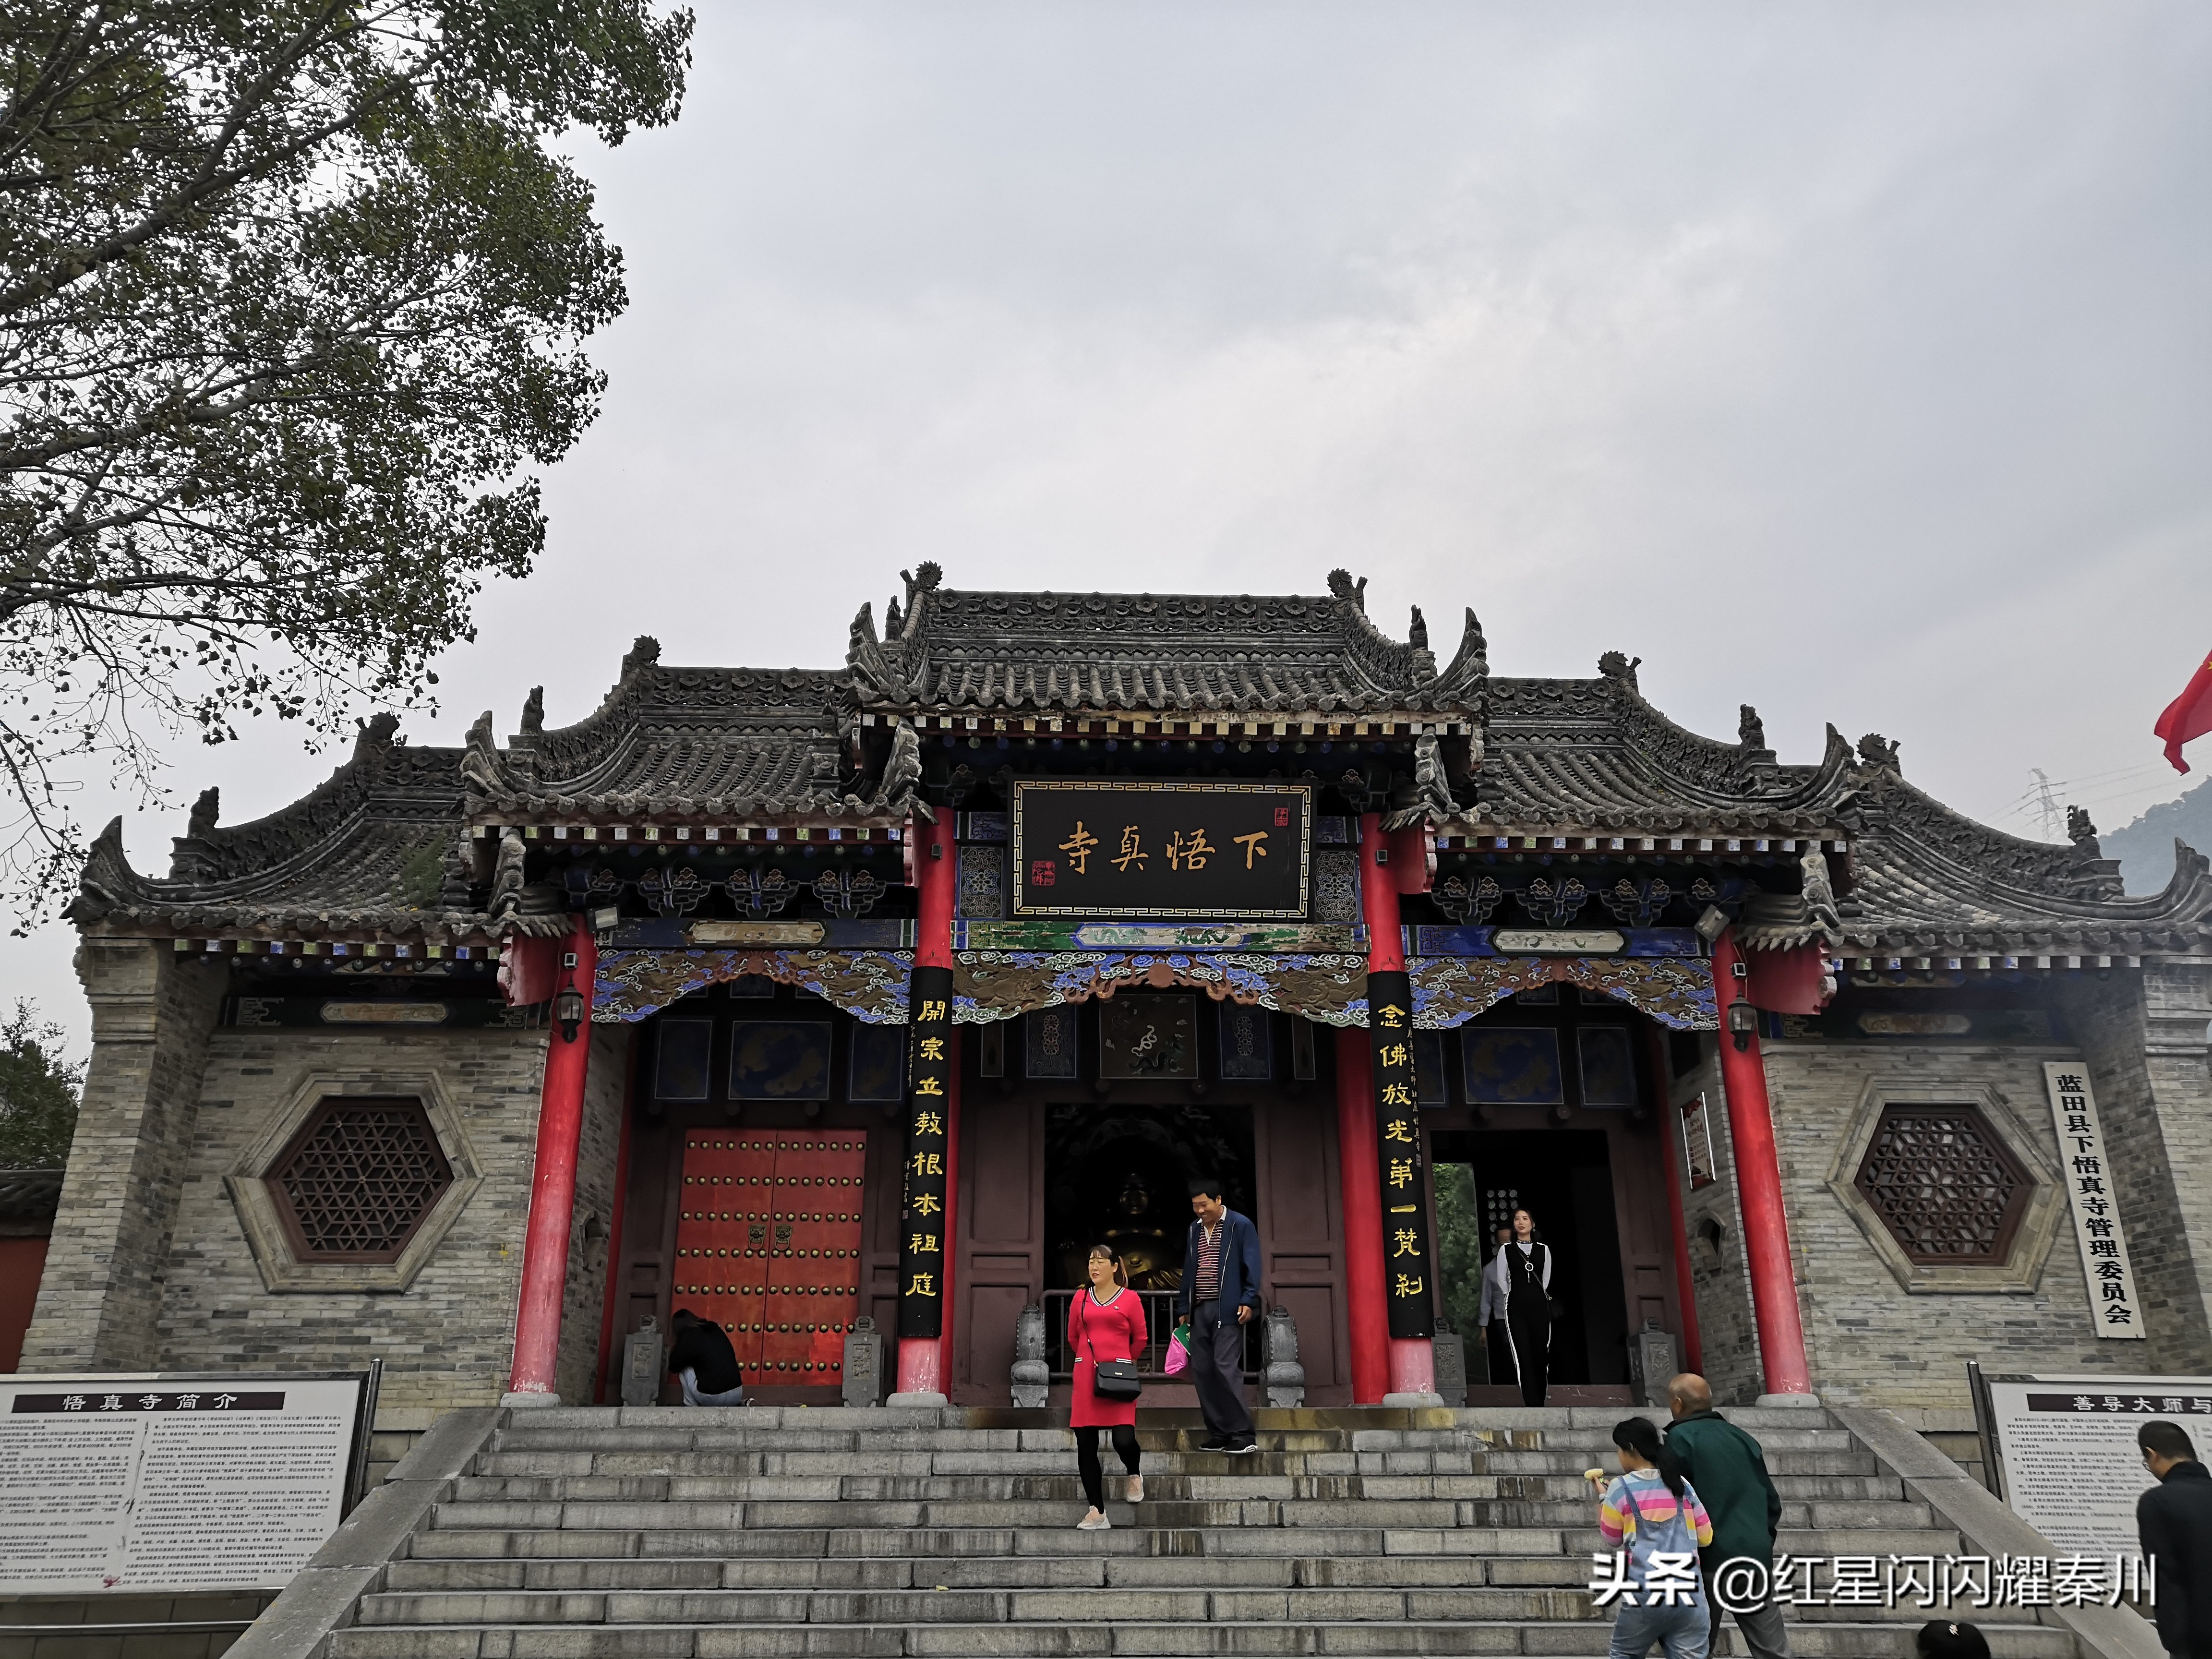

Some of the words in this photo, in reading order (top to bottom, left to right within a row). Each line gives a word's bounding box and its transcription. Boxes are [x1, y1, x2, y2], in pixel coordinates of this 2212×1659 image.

[1058, 820, 1269, 875] 下悟真寺
[905, 1000, 946, 1297] 開宗立教根本祖庭
[2055, 1075, 2132, 1324] 蓝田县下悟真寺管理委员会
[62, 1394, 238, 1411] 悟真寺简介
[2072, 1395, 2212, 1414] 善导大师与
